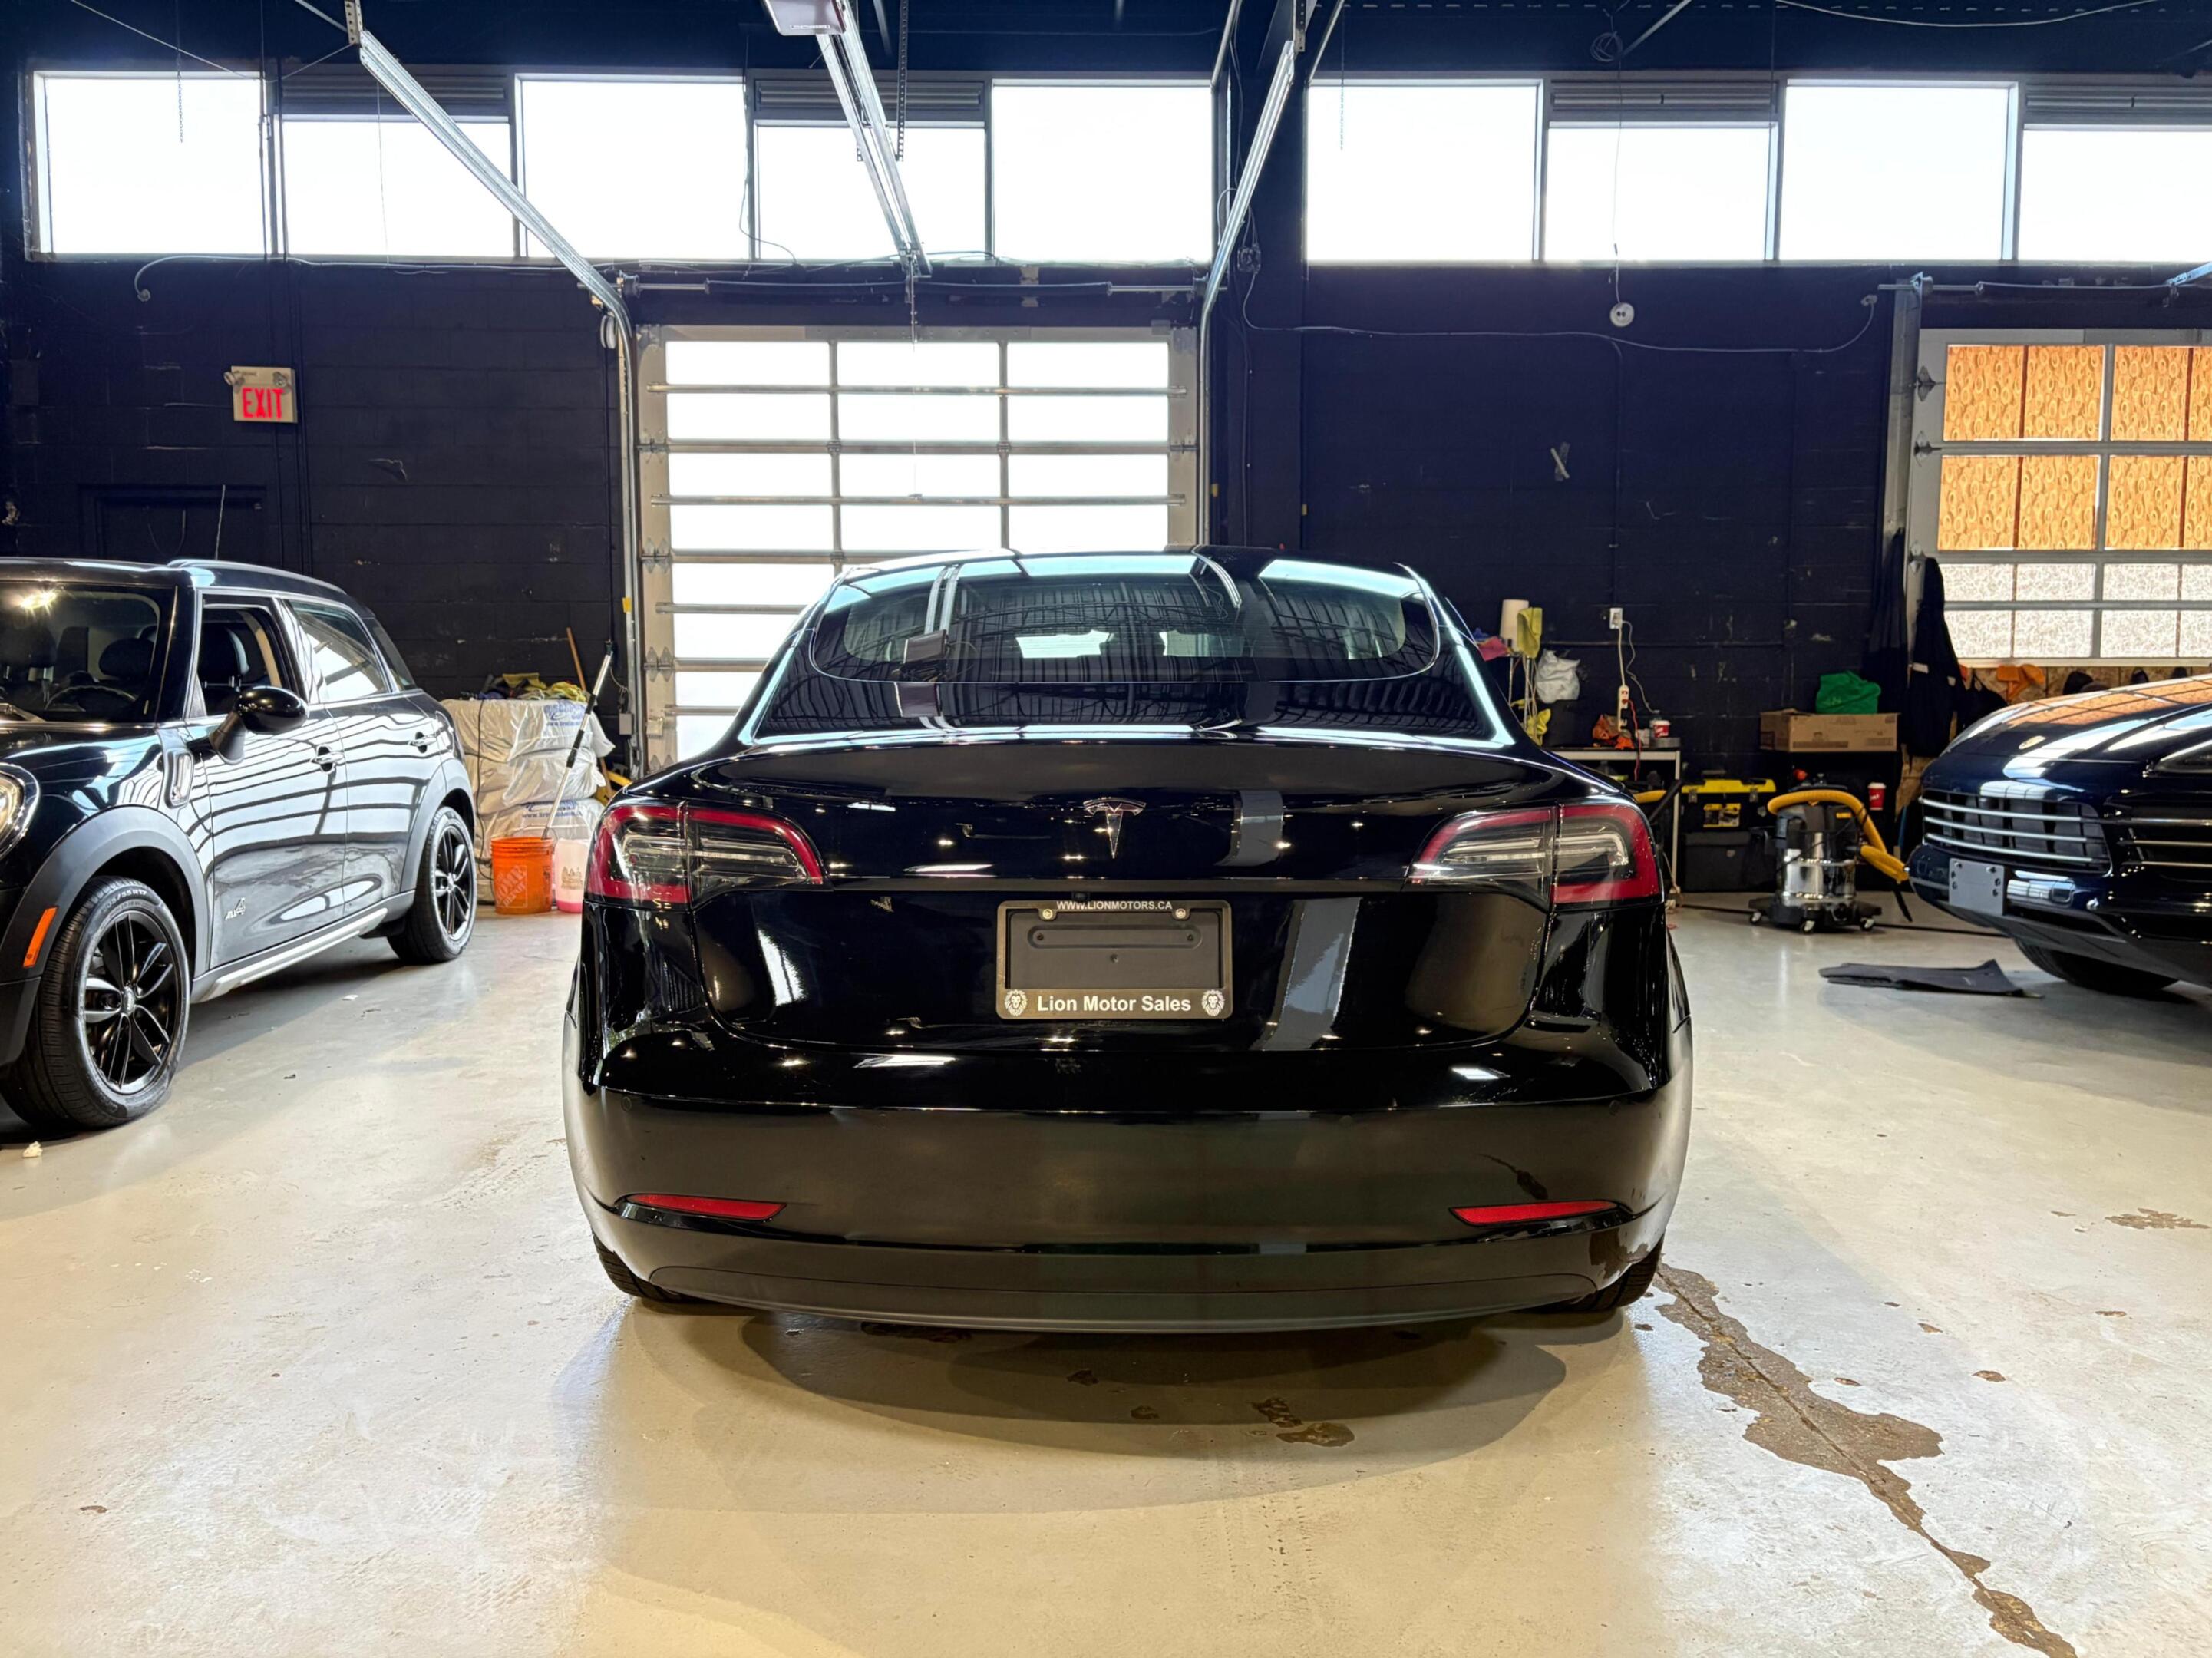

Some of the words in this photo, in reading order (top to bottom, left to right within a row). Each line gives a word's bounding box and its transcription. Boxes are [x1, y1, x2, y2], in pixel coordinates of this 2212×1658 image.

[242, 387, 284, 418] EXIT
[1056, 900, 1173, 910] WWW.LIONMOTORS.CA
[1037, 996, 1078, 1012] Lion
[1083, 996, 1137, 1012] Motor
[1141, 996, 1192, 1012] Sales
